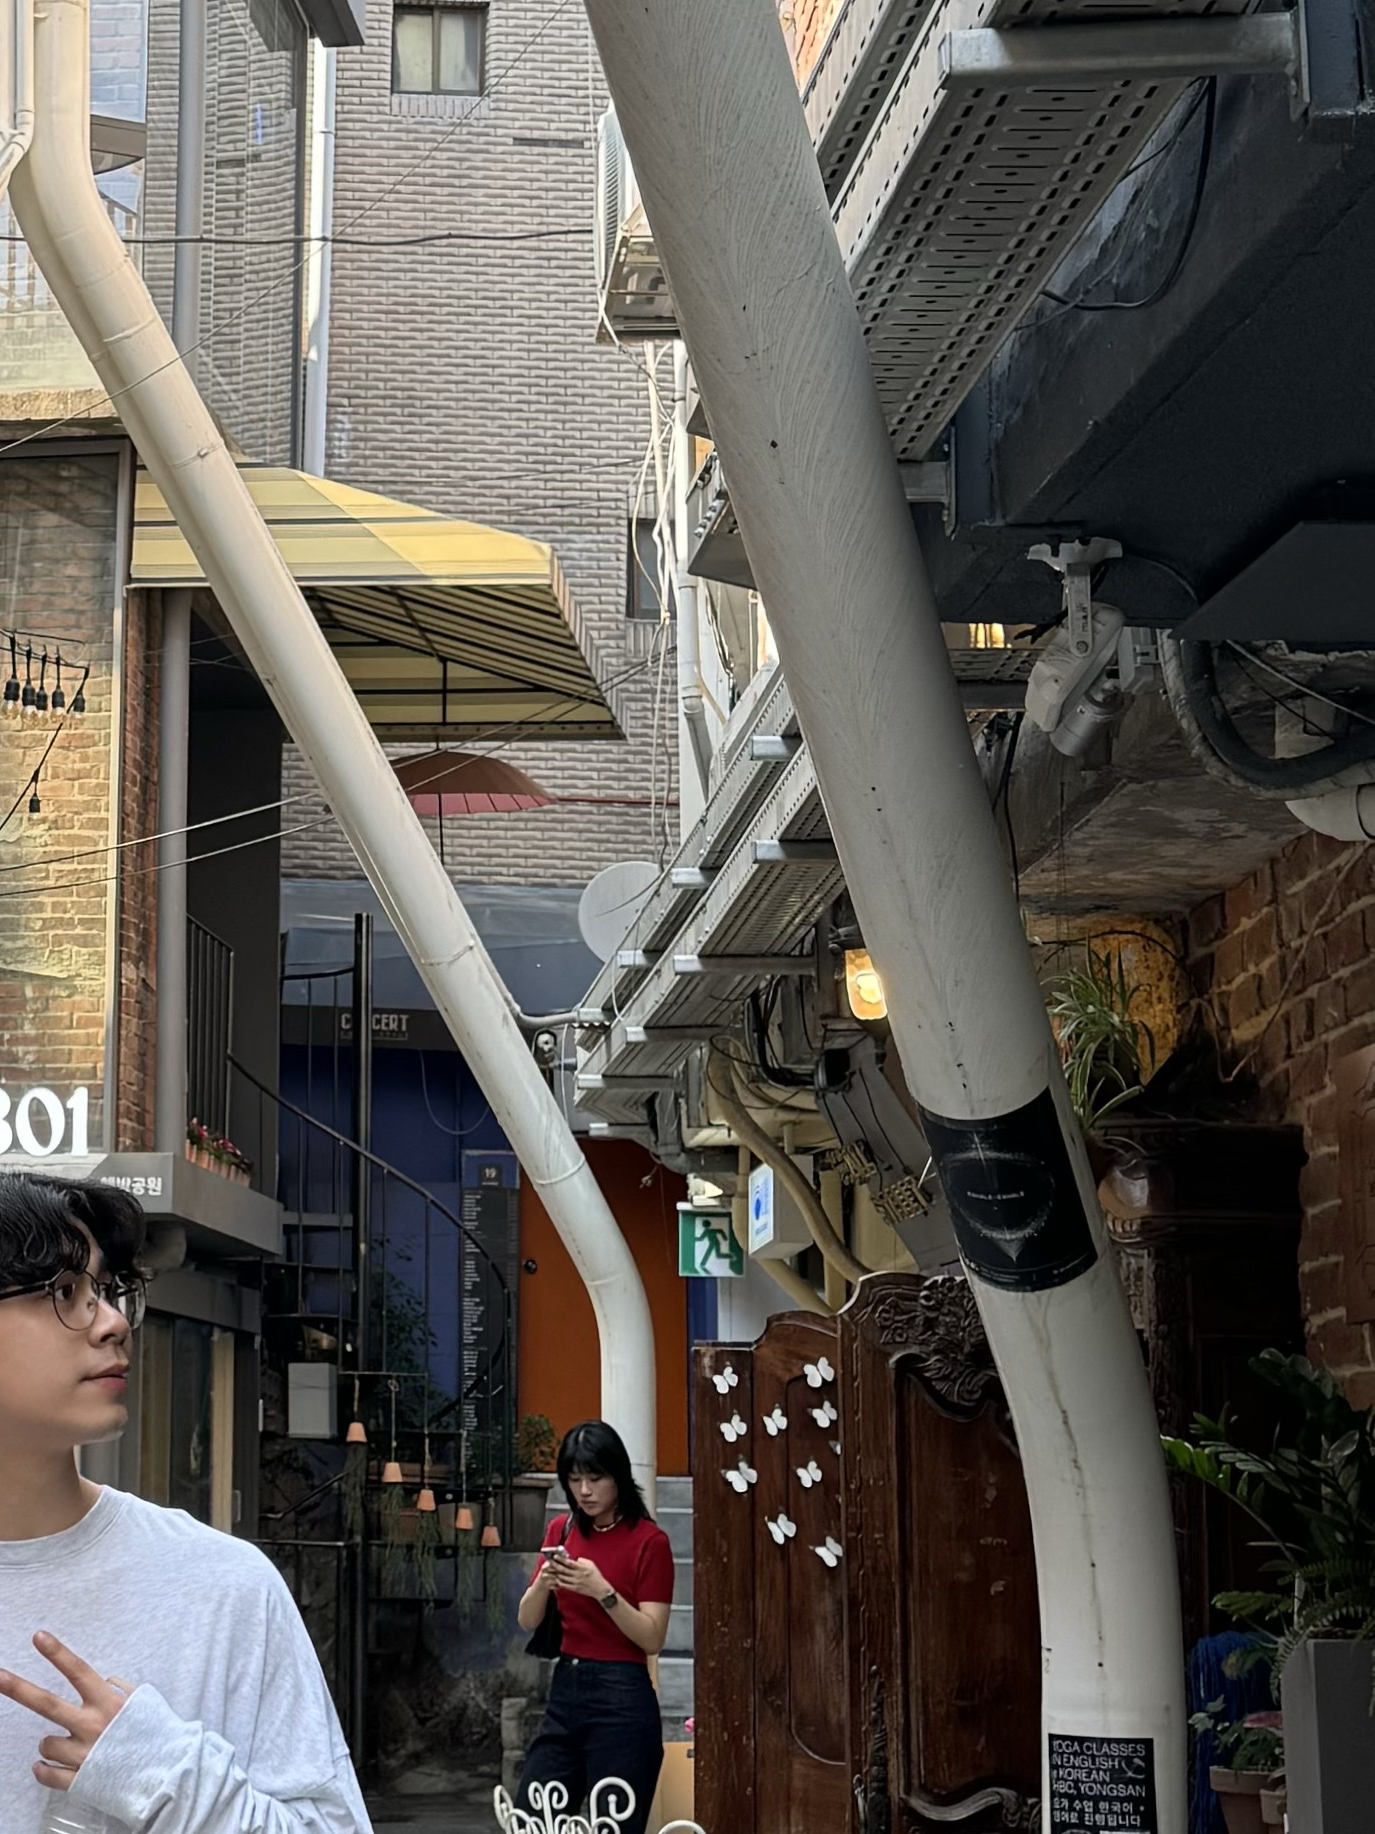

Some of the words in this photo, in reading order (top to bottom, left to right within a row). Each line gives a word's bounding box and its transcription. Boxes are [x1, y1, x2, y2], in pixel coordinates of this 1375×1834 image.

[340, 1012, 410, 1032] CCERT
[1082, 1741, 1146, 1757] CLASSES
[1062, 1754, 1119, 1769] ENGLISH
[1059, 1767, 1111, 1783] KOREAN
[1078, 1782, 1146, 1798] YONGSAN
